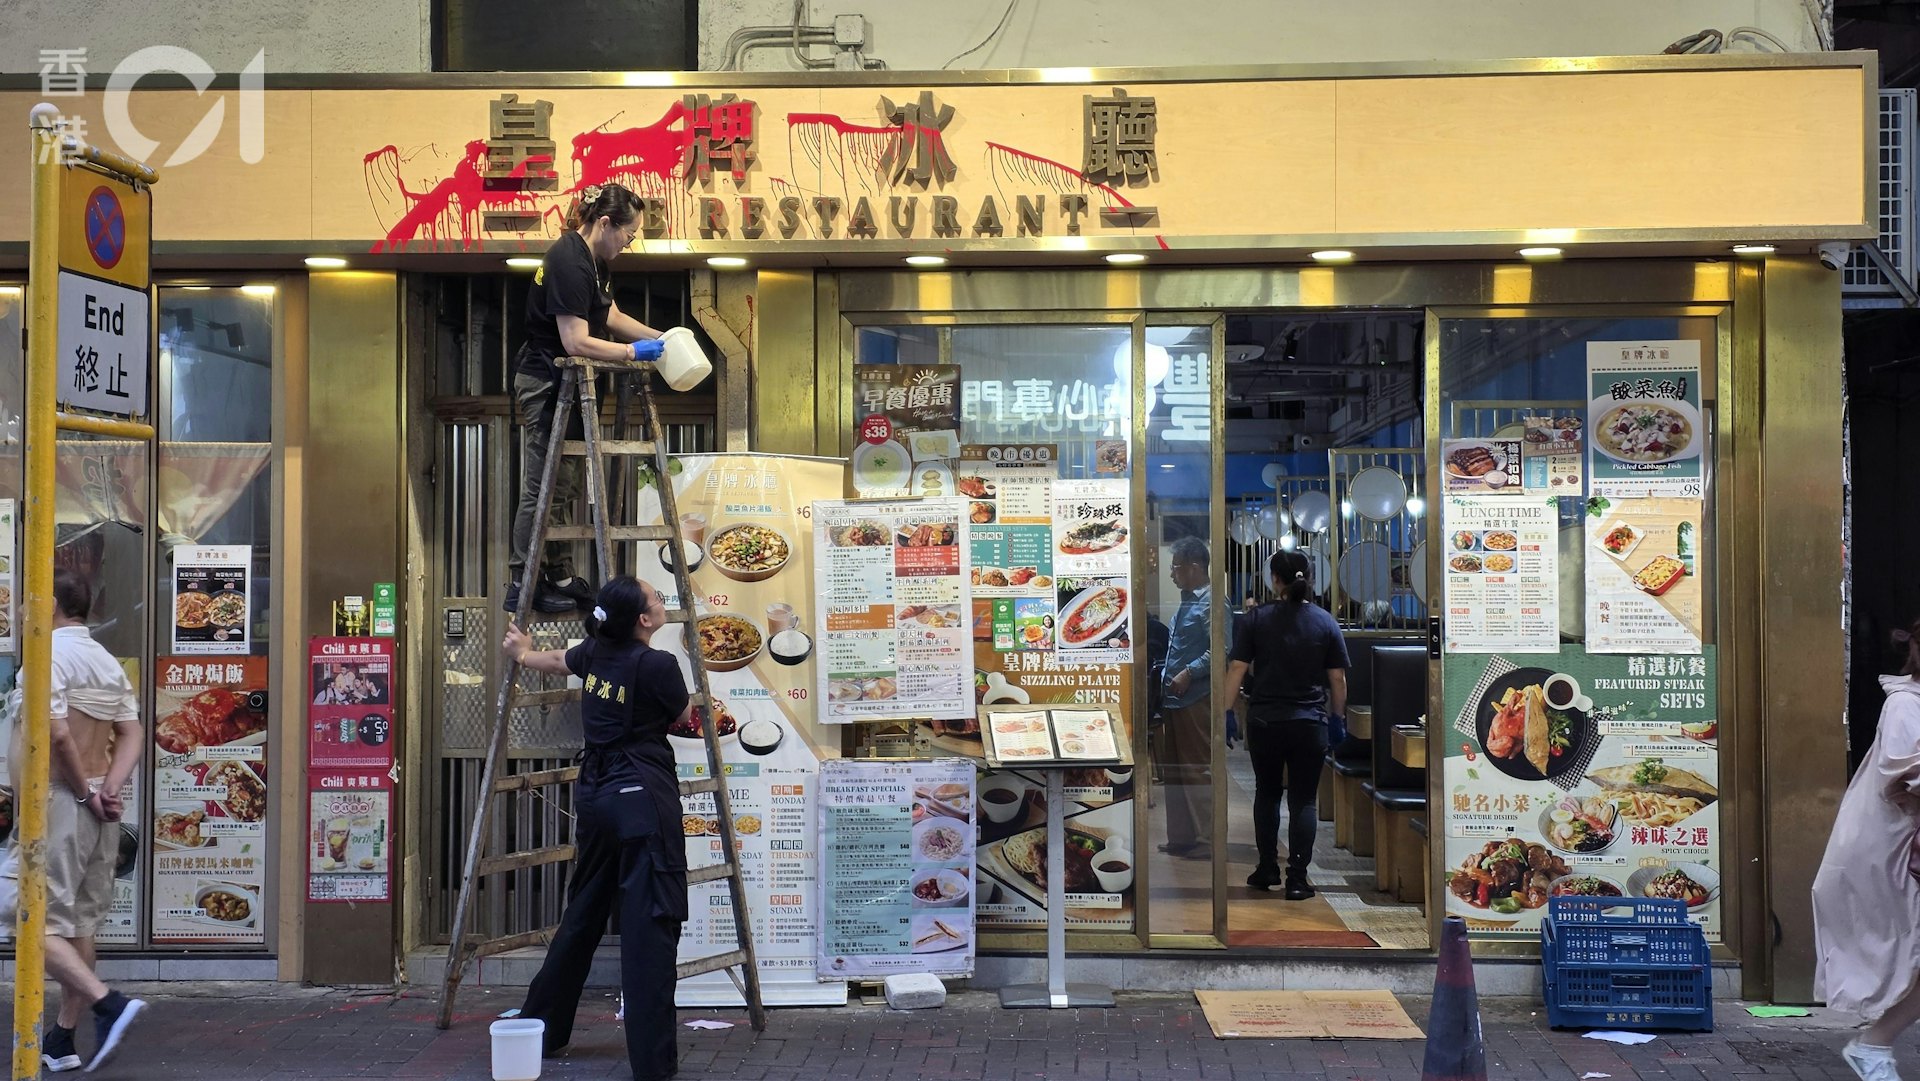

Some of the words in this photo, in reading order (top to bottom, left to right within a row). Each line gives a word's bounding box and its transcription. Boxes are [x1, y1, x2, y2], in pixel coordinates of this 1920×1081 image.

[705, 195, 1089, 239] RESTAURANT
[84, 293, 124, 337] End
[73, 344, 130, 398] 終止
[1609, 378, 1677, 400] 酸菜魚
[862, 383, 954, 412] 早餐優惠
[865, 426, 888, 438] $38
[989, 450, 1047, 459] 晚市優惠
[1637, 463, 1667, 471] Cabbage
[706, 472, 778, 489] 皇牌冰廳
[1679, 483, 1700, 496] $98
[1077, 502, 1123, 520] 珍珠斑
[1461, 508, 1505, 518] LUNCH
[1507, 508, 1542, 518] TIME
[1484, 519, 1519, 528] 精選午餐
[708, 594, 729, 606] $62
[322, 642, 345, 655] Chill
[1628, 656, 1706, 677] 精選扒餐
[165, 663, 244, 685] 金牌焗飯
[1020, 675, 1075, 686] SIZZLING
[1078, 675, 1121, 686] PLATE
[1594, 678, 1660, 690] FEATURED
[1663, 678, 1705, 690] STEAK
[787, 688, 808, 700] $60
[1075, 689, 1120, 704] SETS
[1660, 693, 1705, 709] SETS
[321, 776, 344, 788] Chill
[771, 797, 807, 805] MONDAY
[1453, 793, 1530, 813] 馳名小菜
[1632, 826, 1710, 846] 辣味之選
[770, 852, 816, 860] THURSDAY
[770, 907, 804, 915] SUNDAY
